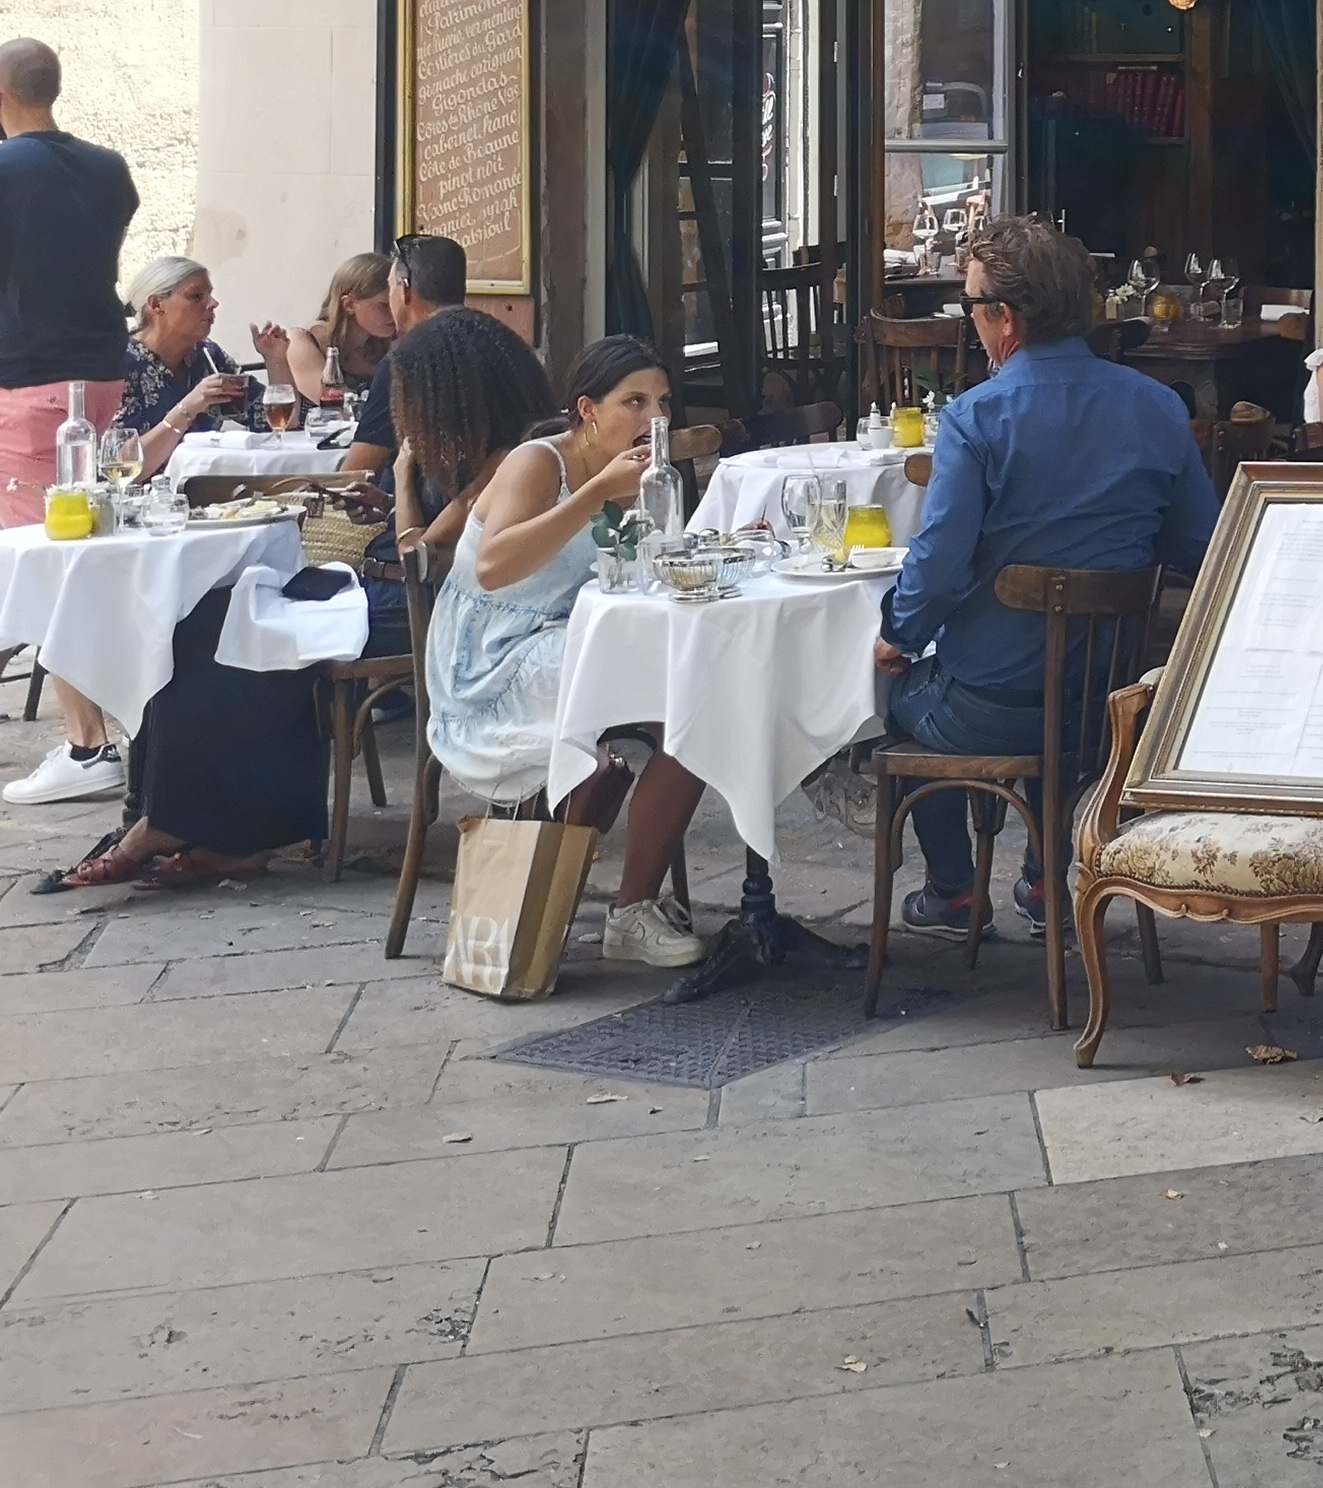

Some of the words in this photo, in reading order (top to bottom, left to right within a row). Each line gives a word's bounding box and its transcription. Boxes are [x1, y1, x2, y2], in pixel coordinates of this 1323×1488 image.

[485, 24, 523, 52] Gard
[432, 73, 510, 116] Gigondas
[463, 130, 520, 164] Beaune
